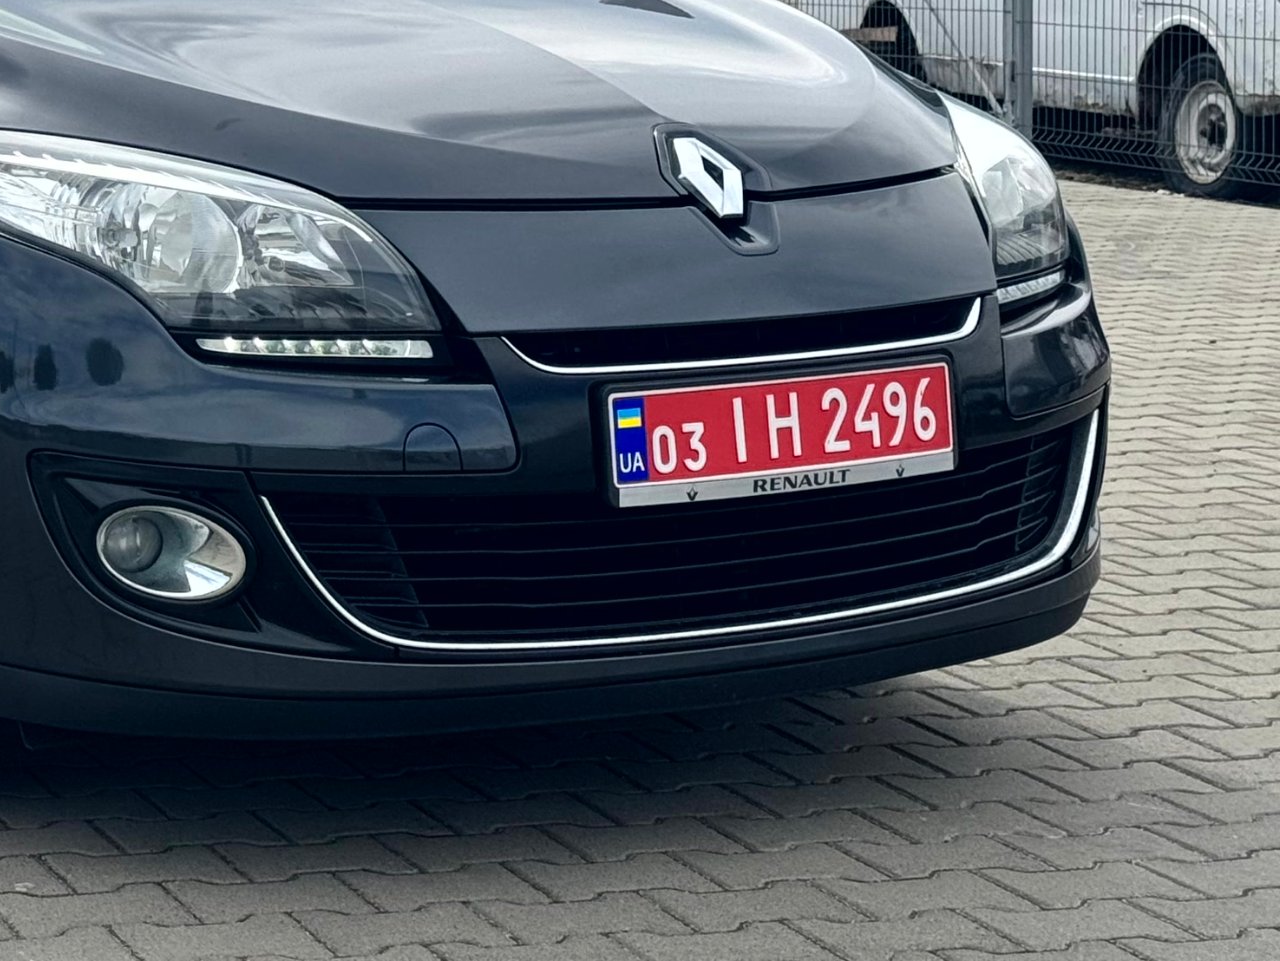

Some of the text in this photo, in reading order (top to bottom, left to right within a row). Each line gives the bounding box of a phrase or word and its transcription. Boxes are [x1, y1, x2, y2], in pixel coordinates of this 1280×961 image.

[619, 451, 646, 474] UA
[652, 421, 708, 475] 03
[821, 376, 938, 455] 2496
[751, 468, 852, 494] RENAULT
